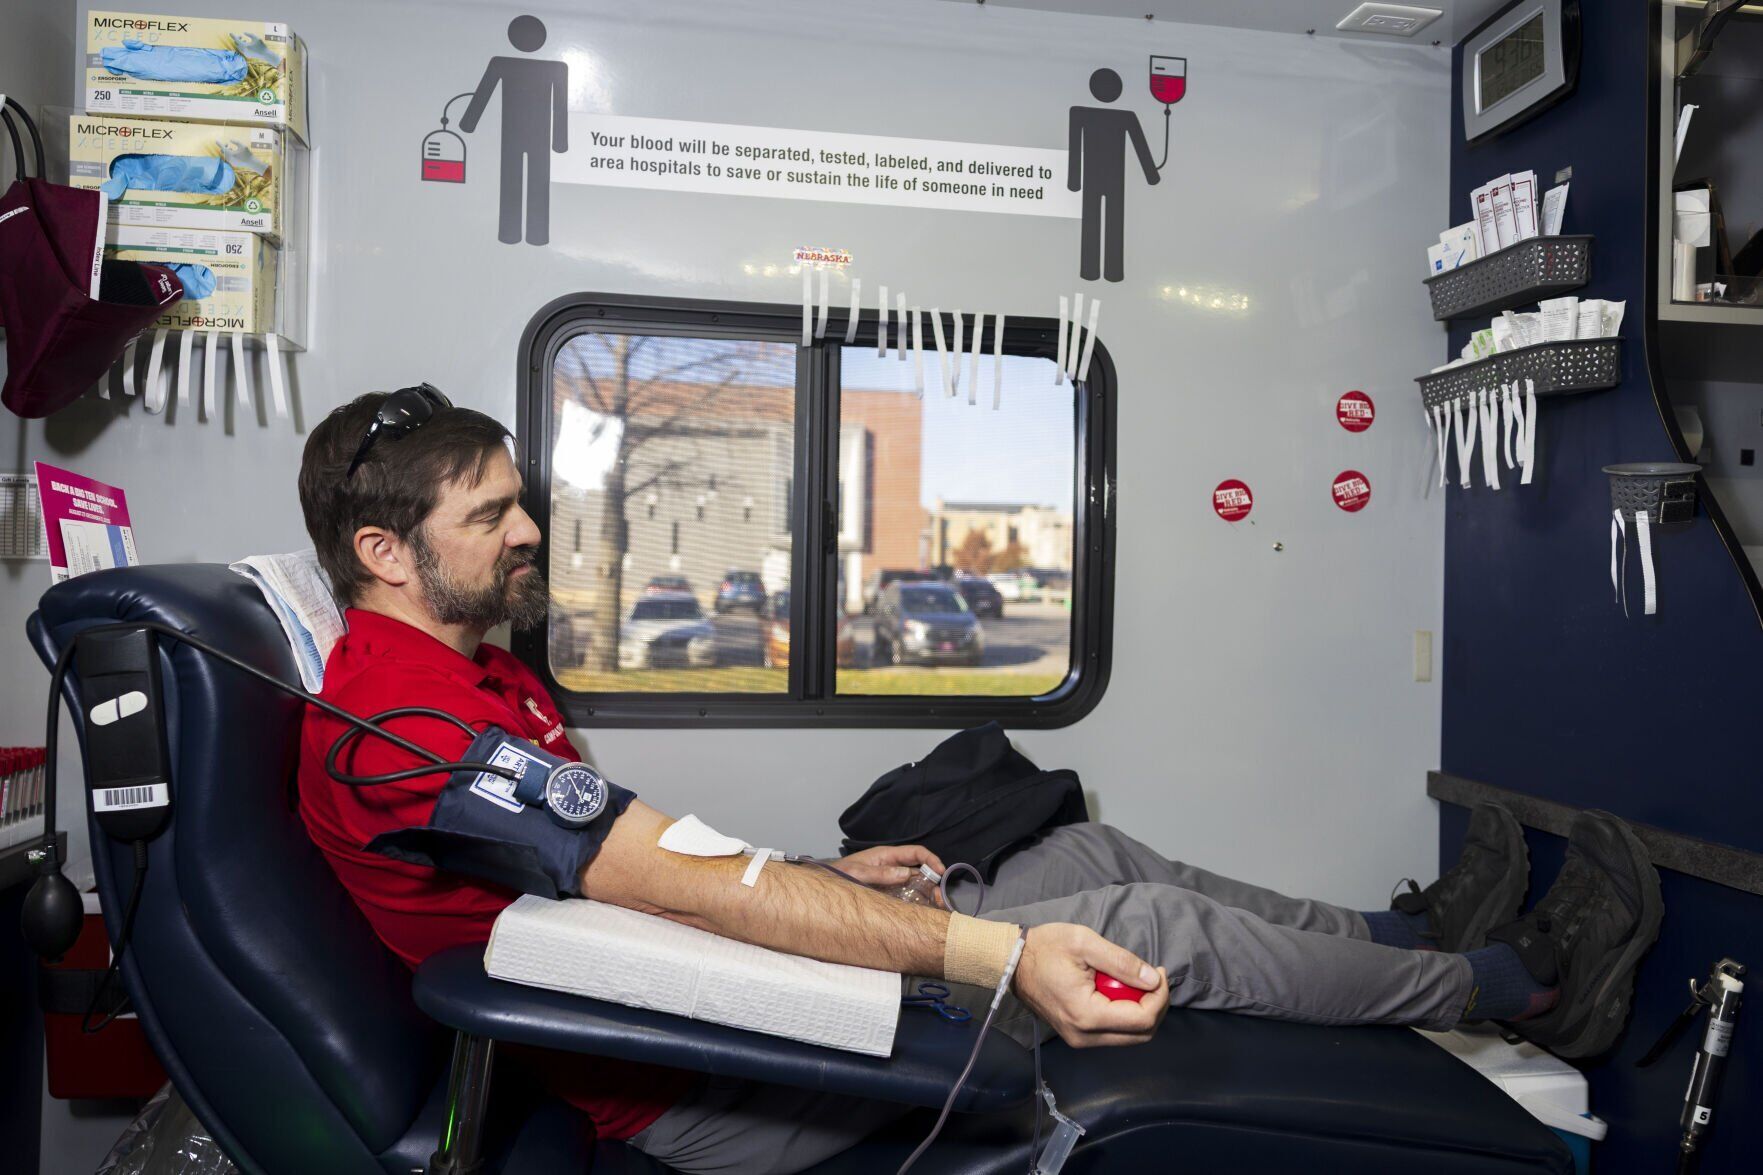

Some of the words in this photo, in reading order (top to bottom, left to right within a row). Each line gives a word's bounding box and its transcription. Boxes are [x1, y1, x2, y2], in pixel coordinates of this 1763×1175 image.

[94, 18, 188, 32] MICROFLEX
[94, 90, 111, 100] 250
[254, 108, 277, 116] Ansell
[77, 123, 173, 139] MICROFLEX
[590, 131, 625, 147] Your
[630, 135, 673, 151] blood
[679, 139, 706, 154] will
[712, 141, 730, 156] be
[735, 145, 815, 165] separated,
[820, 150, 870, 168] tested,
[875, 153, 932, 173] labeled,
[937, 160, 963, 173] and
[968, 161, 1033, 178] delivered
[1039, 166, 1052, 179] to
[590, 157, 624, 170] area
[630, 157, 701, 176] hospitals
[707, 163, 721, 177] to
[726, 166, 761, 180] save
[767, 170, 782, 181] or
[787, 170, 841, 186] sustain
[847, 173, 870, 188] the
[875, 175, 898, 190] life
[903, 178, 917, 191] of
[922, 180, 987, 196] someone
[992, 183, 1004, 197] in
[1010, 186, 1043, 200] need
[241, 218, 264, 226] Ansell
[225, 244, 242, 254] 250
[796, 252, 850, 263] NEBRASKA
[1699, 1111, 1707, 1120] 5
